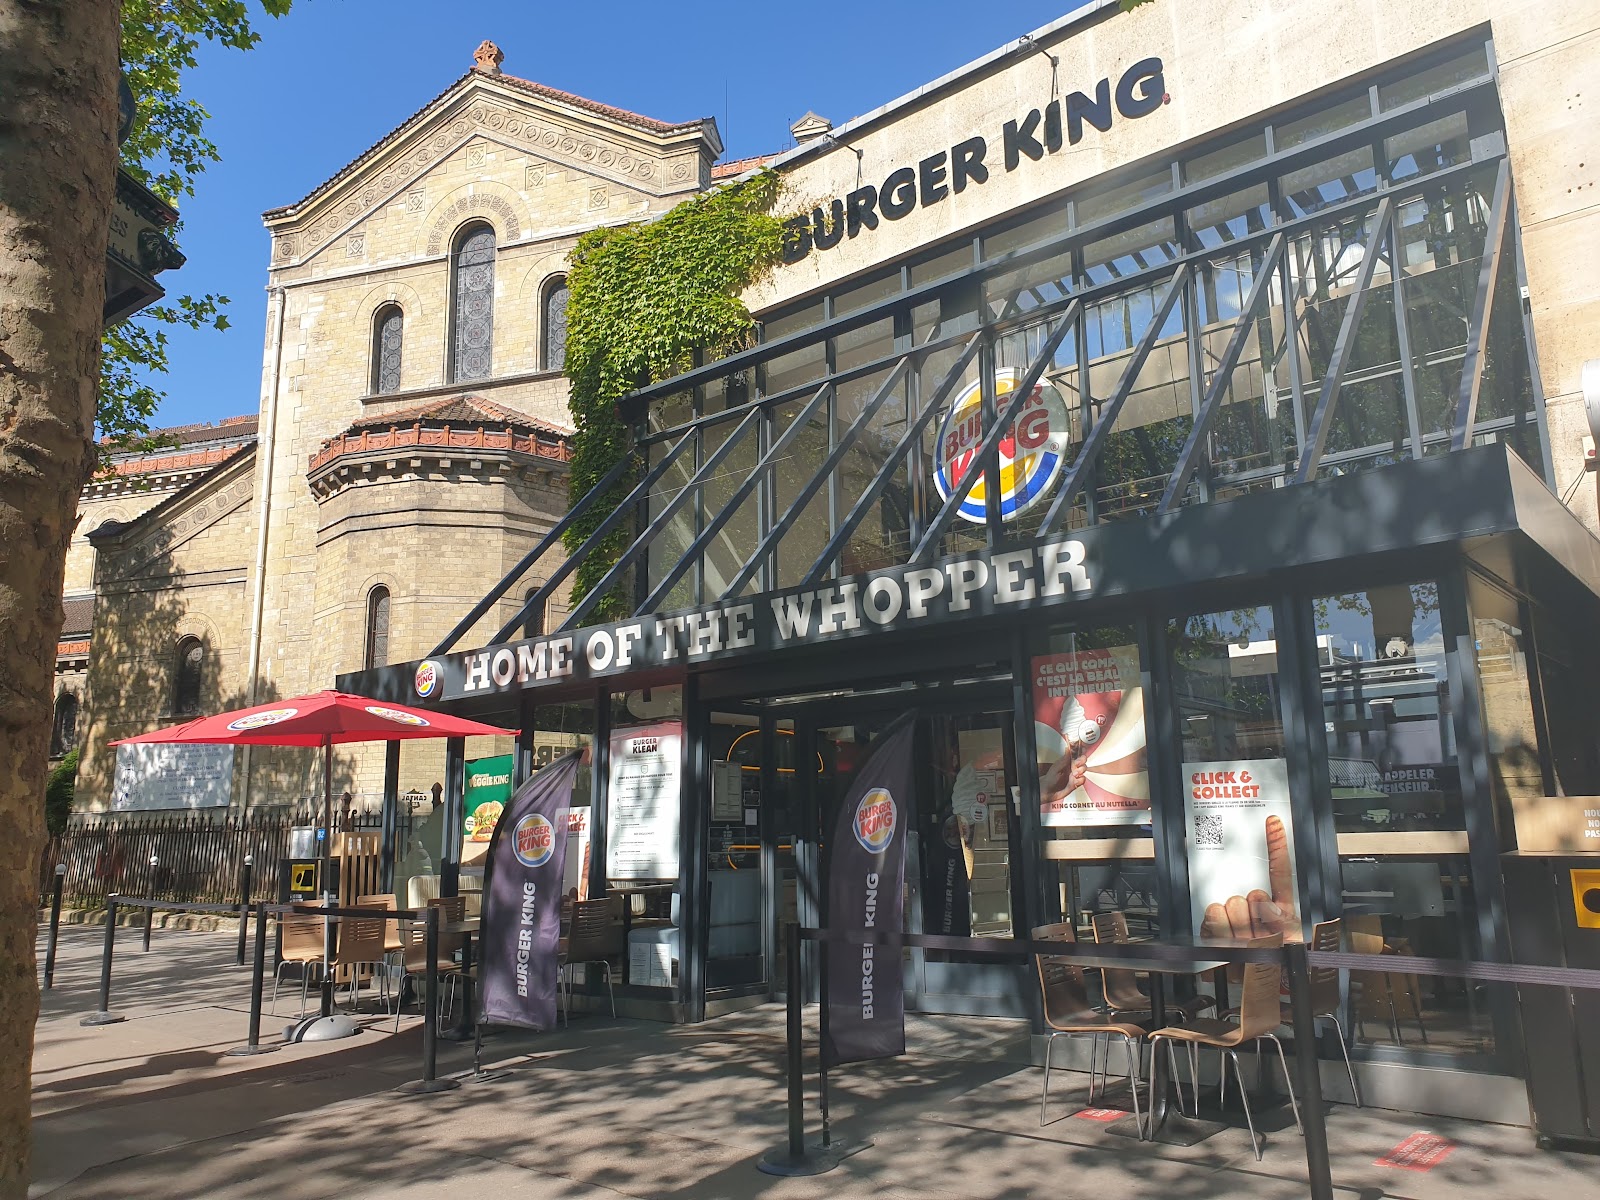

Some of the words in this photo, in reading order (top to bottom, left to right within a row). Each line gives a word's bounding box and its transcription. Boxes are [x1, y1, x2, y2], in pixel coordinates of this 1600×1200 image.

[783, 135, 990, 265] BURGER
[1002, 56, 1166, 173] KING
[463, 636, 574, 692] HOME
[586, 623, 642, 671] OF
[655, 602, 756, 661] THE
[770, 539, 1092, 642] WHOPPER
[1039, 663, 1054, 675] CE
[1055, 659, 1079, 673] QUI
[1081, 655, 1133, 670] COMP
[417, 672, 434, 687] KING
[1036, 674, 1067, 687] C'EST
[1068, 672, 1085, 684] LA
[1086, 666, 1136, 682] BEAU
[632, 737, 657, 746] BURGER
[632, 744, 658, 755] KLEAN
[493, 773, 510, 786] KING
[1191, 770, 1237, 785] CLICK
[1239, 770, 1252, 784] &
[1384, 768, 1435, 780] APPELER
[1192, 784, 1260, 800] COLLECT
[858, 800, 892, 823] BURGER
[1051, 801, 1069, 810] KING
[1069, 801, 1095, 809] CORNET
[517, 824, 550, 841] BURGER
[860, 811, 893, 838] KING
[518, 834, 551, 853] KING
[521, 881, 536, 926] KING
[864, 872, 880, 928] KING
[516, 929, 533, 998] BURGER
